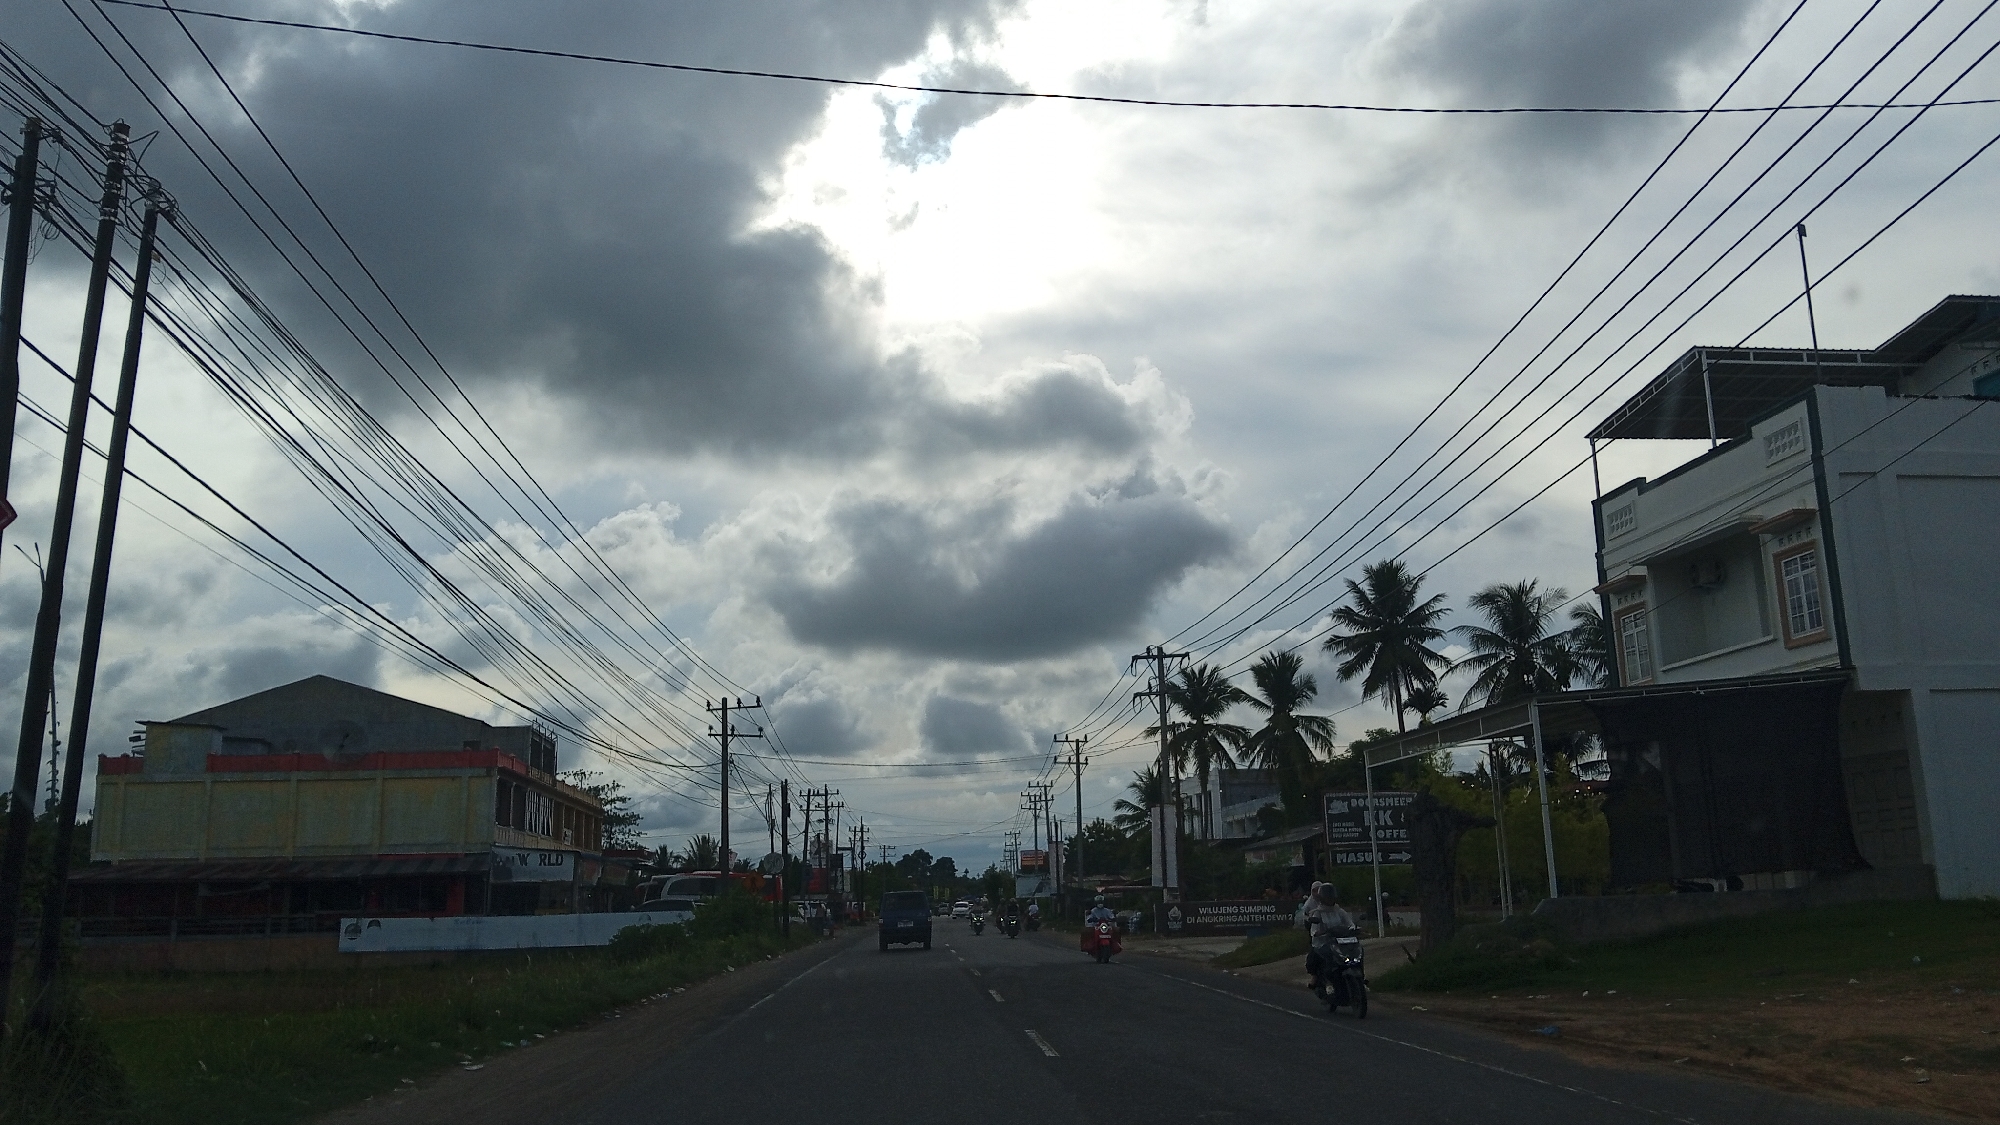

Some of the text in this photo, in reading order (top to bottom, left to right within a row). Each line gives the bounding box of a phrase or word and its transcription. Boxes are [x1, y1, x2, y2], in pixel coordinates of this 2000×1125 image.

[1198, 905, 1276, 914] WILUJENG SUMPING
[1186, 916, 1195, 924] DI
[1196, 915, 1249, 923] ANGKRINGAN
